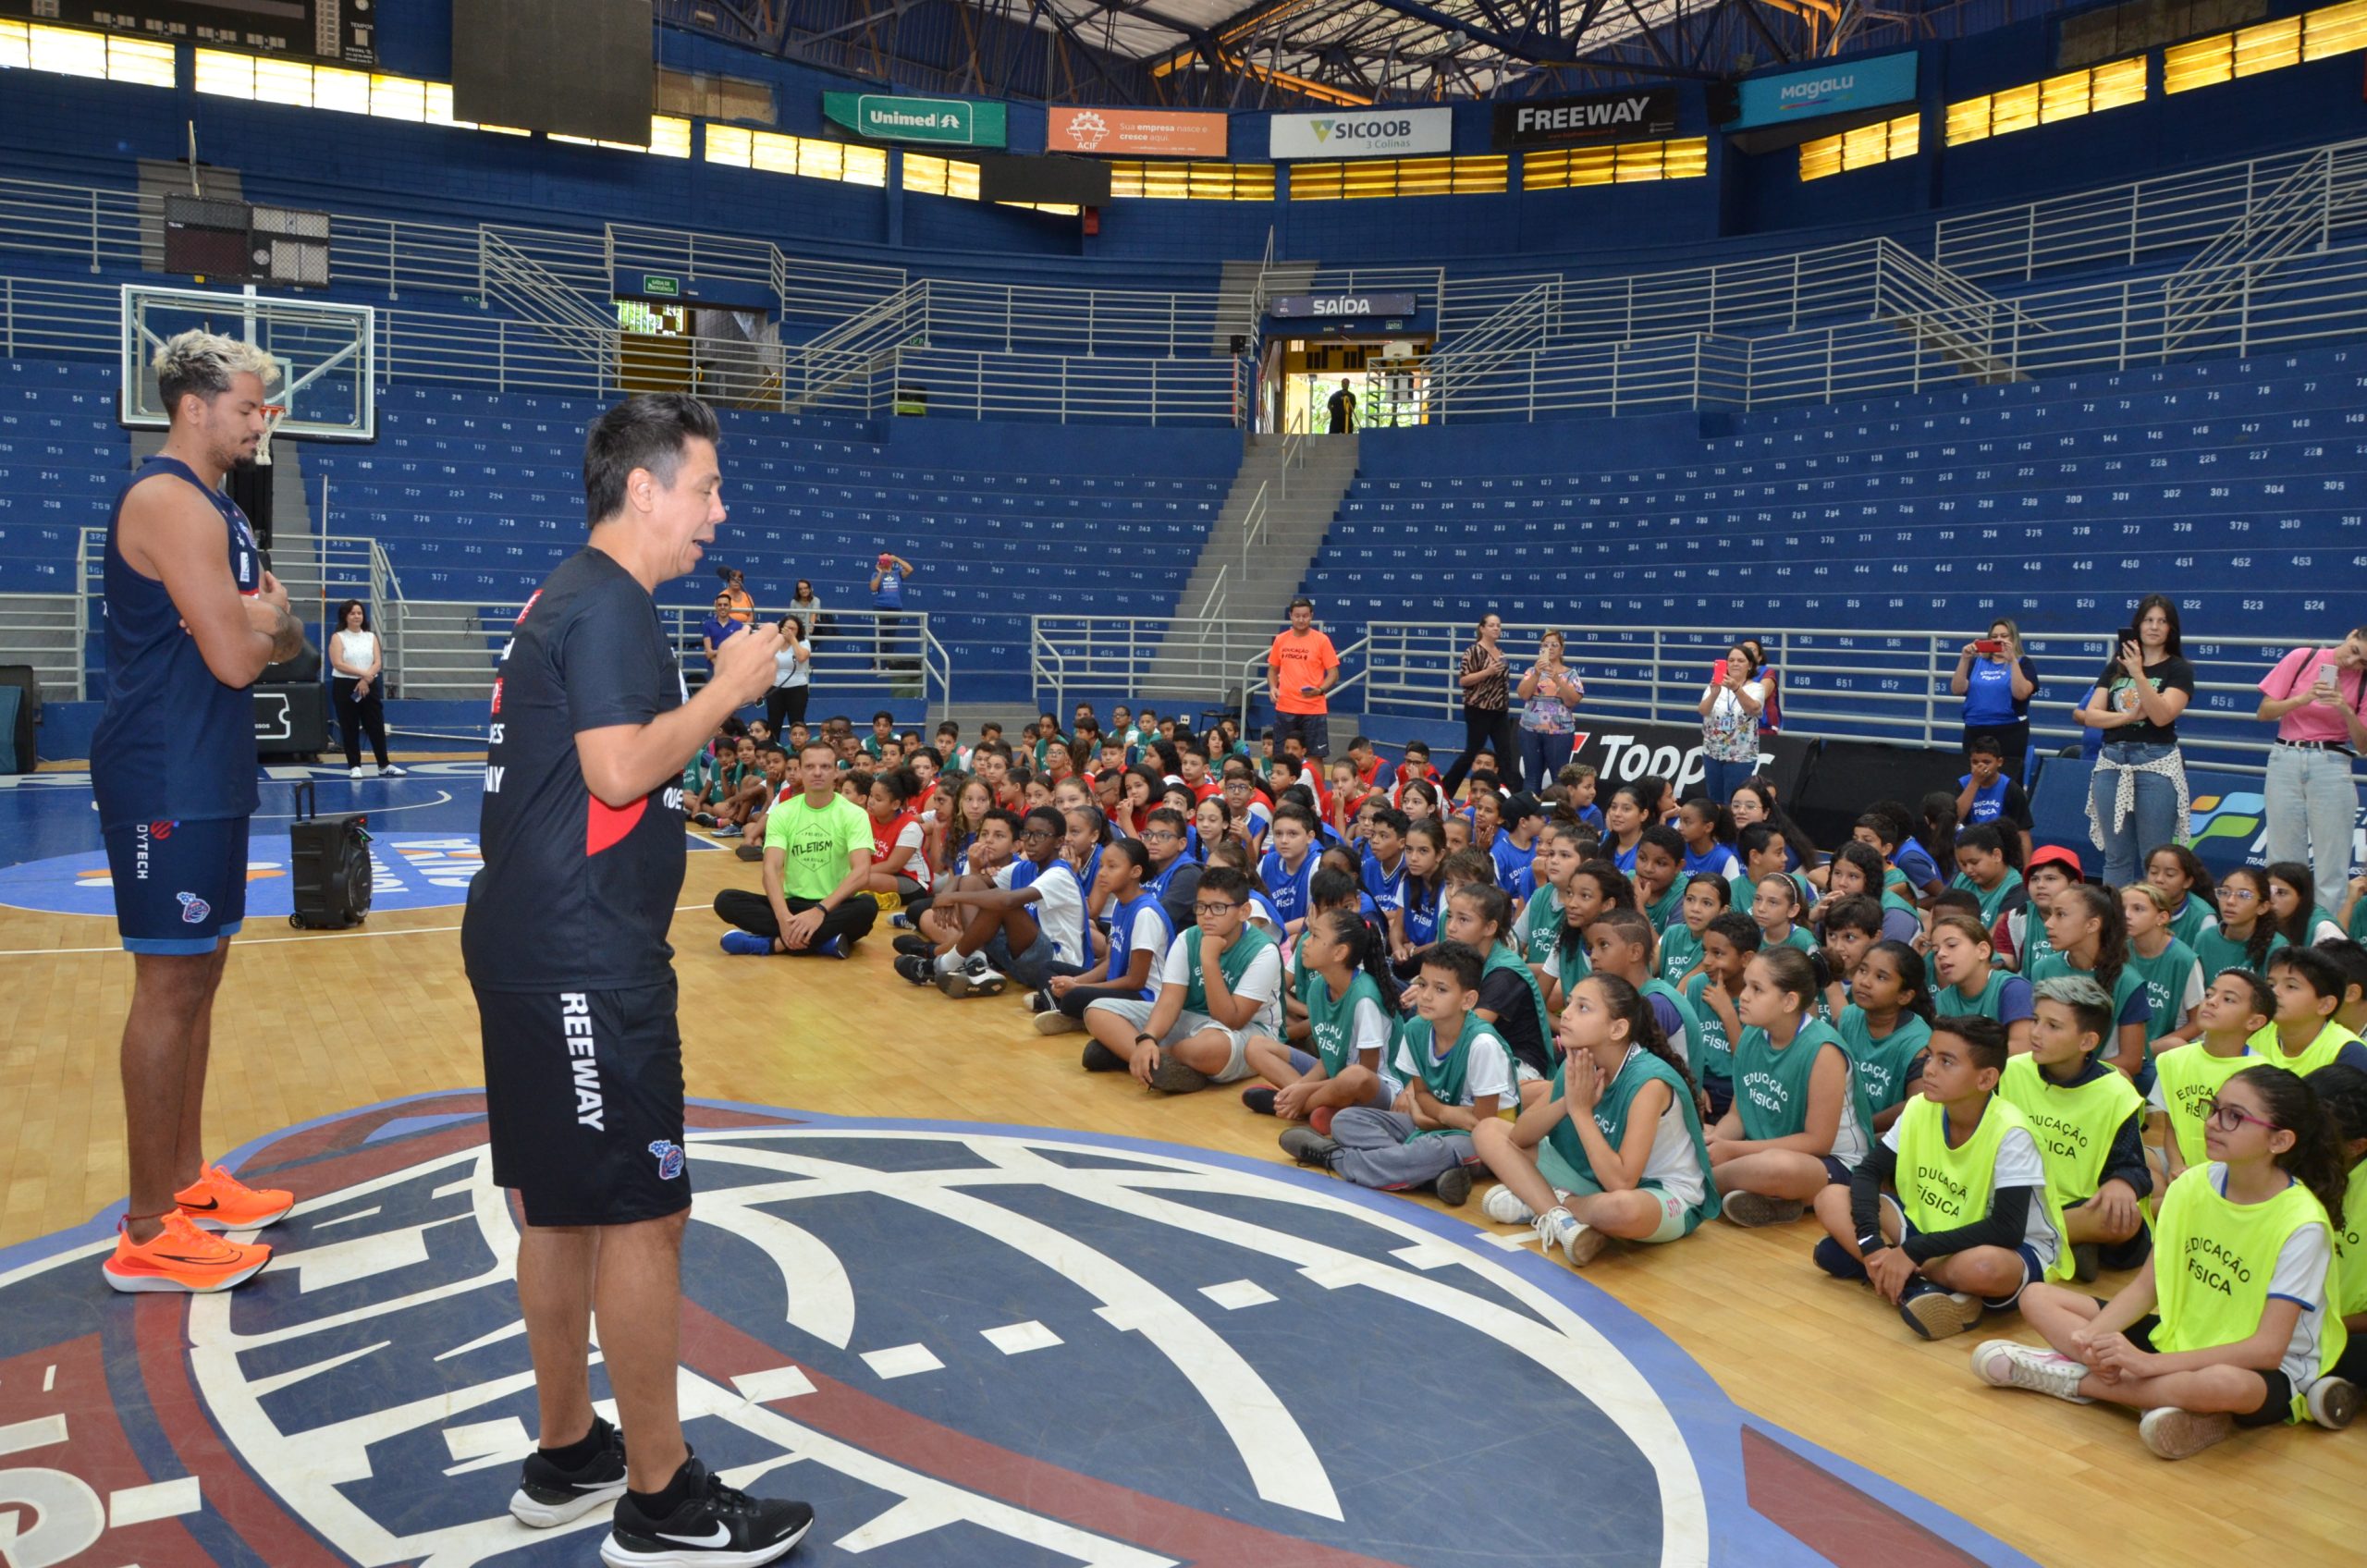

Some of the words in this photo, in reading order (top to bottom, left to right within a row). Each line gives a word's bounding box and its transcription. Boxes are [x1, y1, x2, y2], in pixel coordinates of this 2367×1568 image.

[870, 110, 936, 127] Unimed
[1517, 96, 1650, 132] FREEWAY
[1137, 125, 1175, 133] empresa
[1335, 120, 1411, 139] SICOOB
[1077, 141, 1098, 151] ACIF
[1367, 141, 1372, 149] 3
[1375, 139, 1410, 149] Colinas
[1313, 295, 1370, 314] SAÍDA
[2336, 352, 2347, 361] 17
[2239, 364, 2250, 373] 15
[2152, 373, 2163, 381] 13
[2258, 386, 2271, 395] 76
[2304, 383, 2316, 391] 77
[72, 395, 83, 403] 54
[2165, 396, 2177, 404] 74
[2345, 413, 2365, 423] 149
[2242, 423, 2260, 432] 147
[2292, 419, 2310, 428] 148
[2193, 425, 2209, 435] 146
[2148, 431, 2163, 439] 145
[2018, 442, 2031, 450] 142
[2060, 437, 2074, 446] 143
[1943, 447, 1956, 456] 140
[2250, 448, 2269, 459] 227
[2304, 447, 2323, 456] 228
[2151, 459, 2167, 467] 225
[2199, 454, 2216, 464] 226
[2105, 461, 2121, 470] 224
[41, 472, 59, 480] 214
[2018, 468, 2034, 476] 222
[90, 474, 106, 483] 215
[2264, 484, 2285, 494] 304
[2324, 481, 2345, 490] 305
[2113, 492, 2129, 500] 301
[2164, 489, 2181, 498] 302
[2211, 488, 2229, 496] 303
[2280, 520, 2300, 529] 380
[2342, 517, 2361, 525] 381
[2123, 525, 2140, 533] 377
[2173, 522, 2192, 532] 378
[2230, 521, 2250, 531] 379
[1982, 530, 1997, 538] 374
[2072, 561, 2092, 570] 449
[2121, 559, 2140, 569] 450
[2175, 557, 2193, 567] 451
[2231, 557, 2250, 567] 452
[2291, 556, 2312, 566] 453
[1814, 567, 1828, 575] 443
[1854, 565, 1870, 573] 444
[1892, 564, 1908, 573] 445
[1977, 563, 1993, 571] 447
[1846, 599, 1859, 607] 515
[1932, 599, 1946, 607] 517
[1979, 599, 1993, 608] 518
[2077, 598, 2095, 607] 520
[2183, 600, 2201, 609] 522
[2243, 600, 2263, 610] 523
[2304, 600, 2325, 610] 524
[2199, 644, 2219, 655] 591
[2262, 646, 2284, 657] 592
[1600, 735, 1775, 799] Toppr
